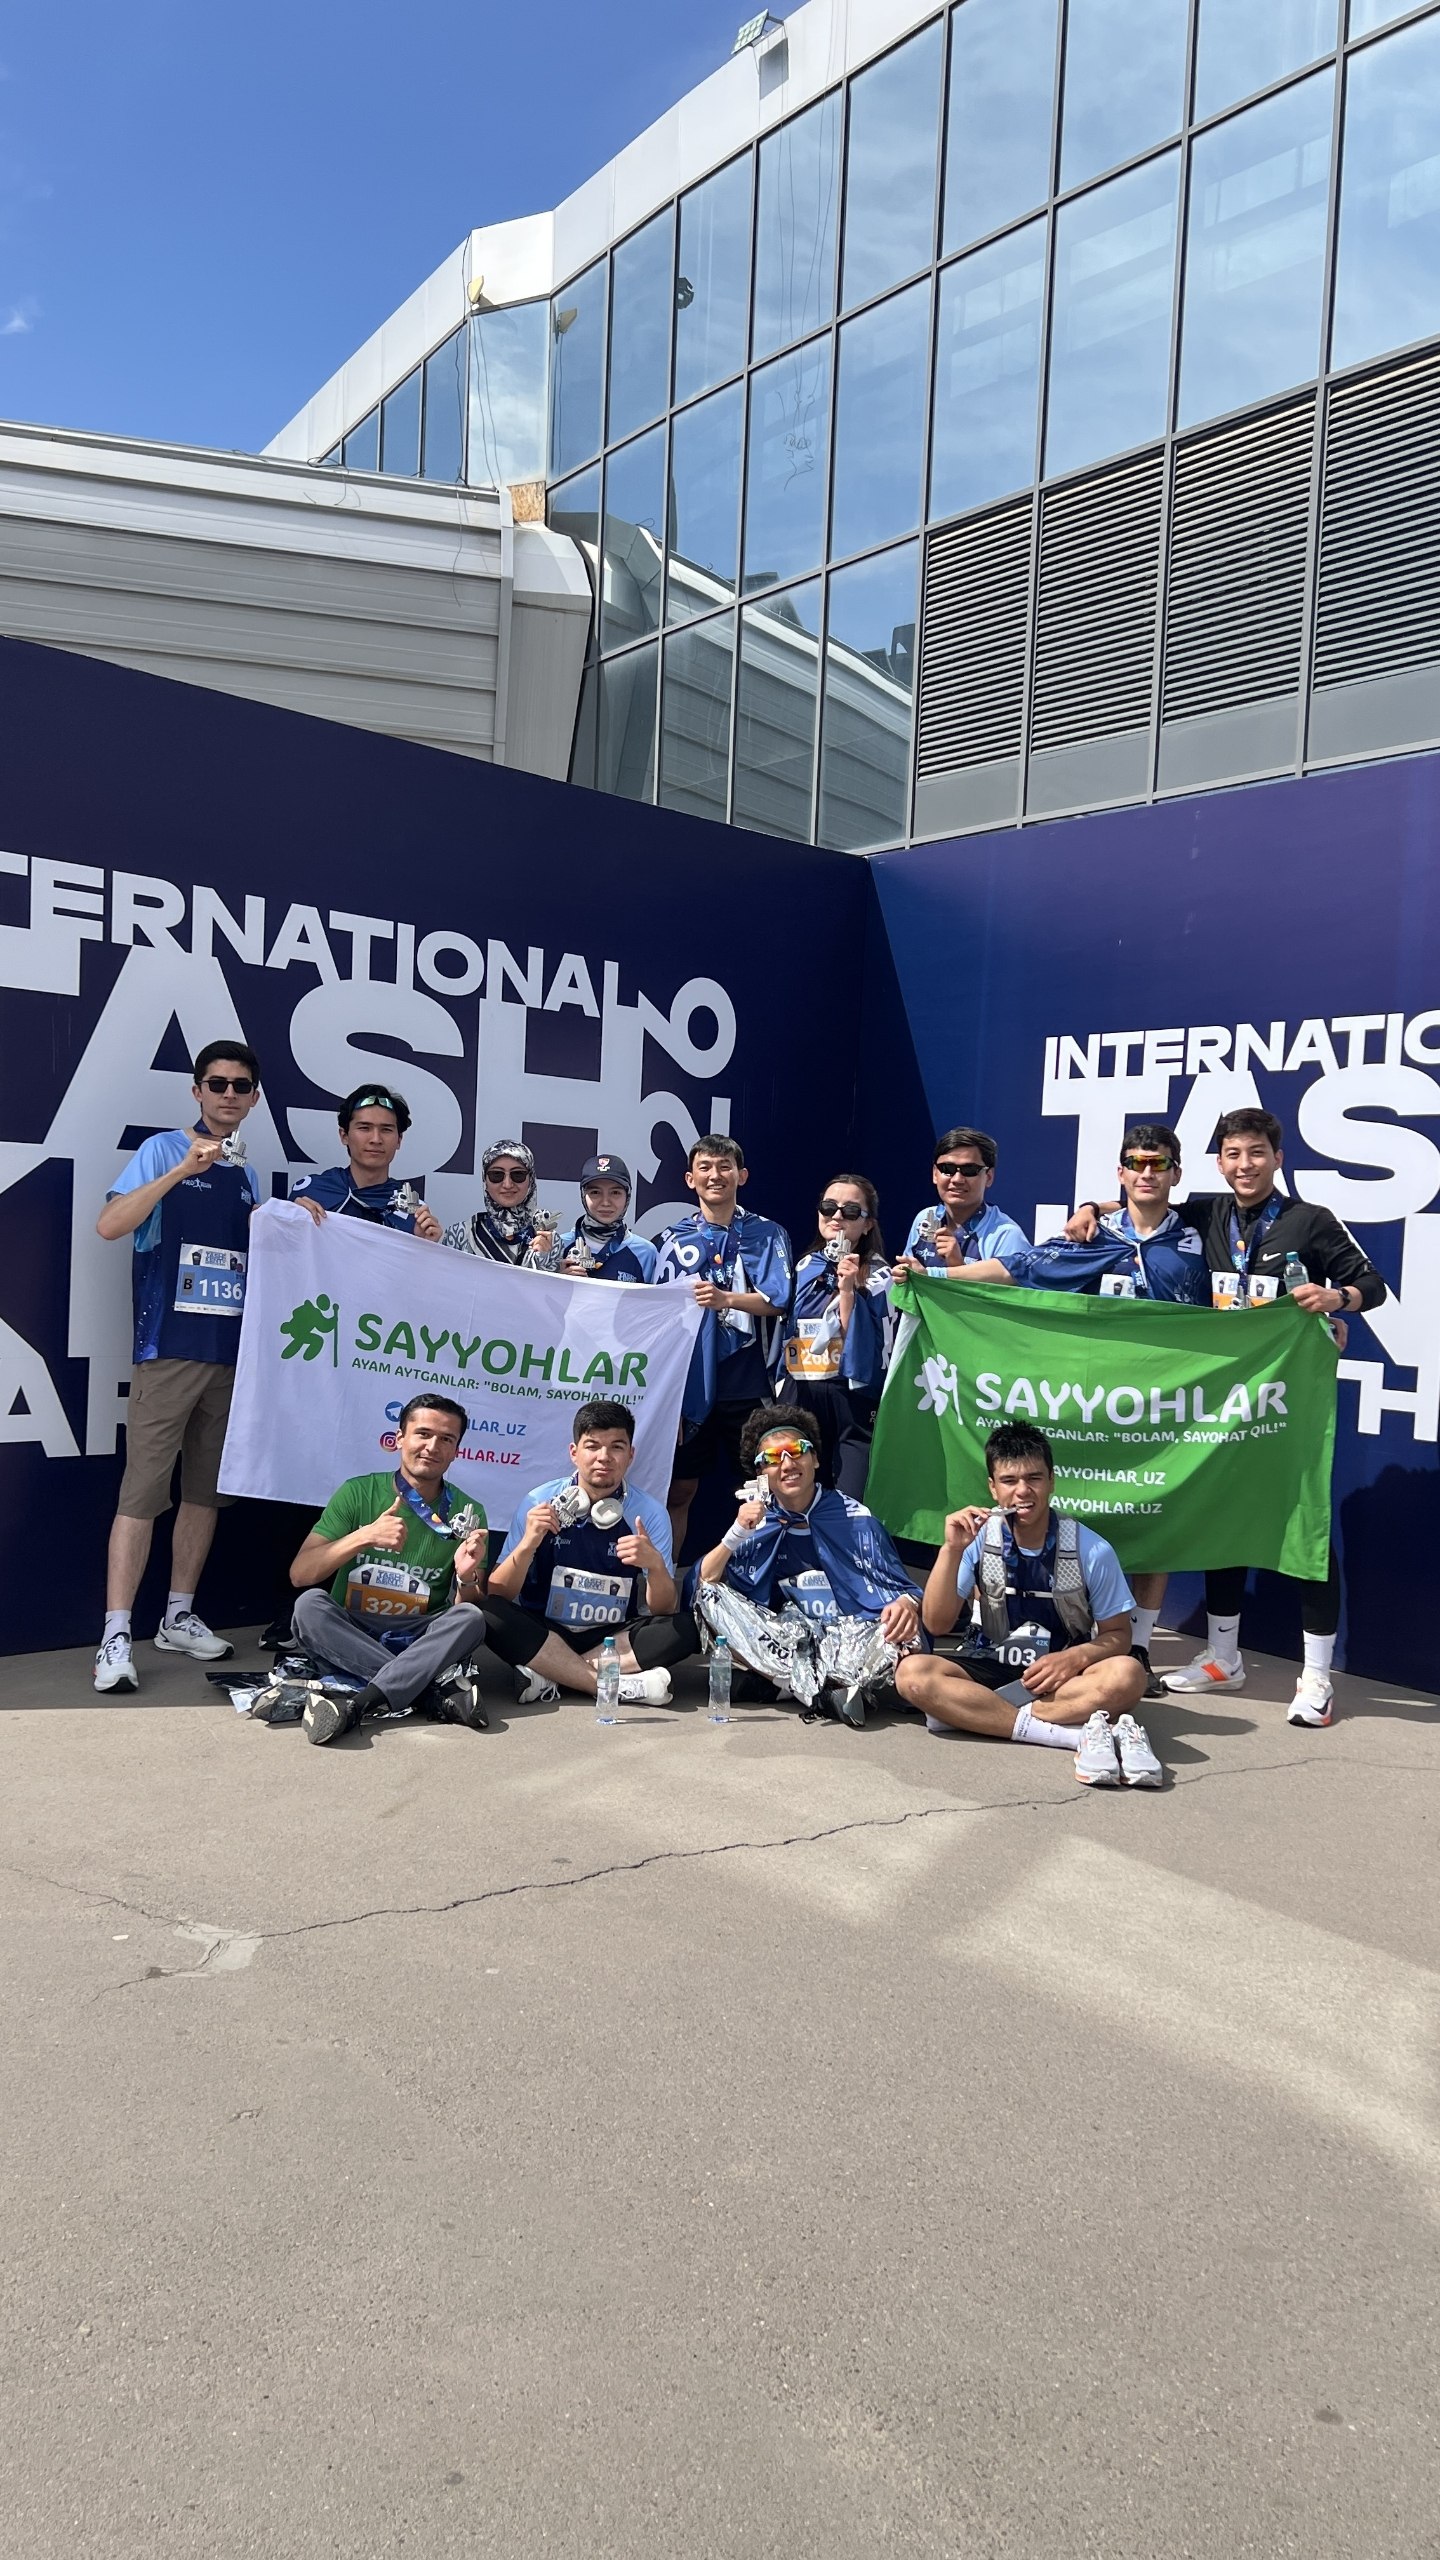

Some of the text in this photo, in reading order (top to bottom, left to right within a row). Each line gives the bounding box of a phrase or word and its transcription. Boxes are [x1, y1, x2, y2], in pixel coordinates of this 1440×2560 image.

[183, 1278, 243, 1300] B 1136
[355, 1313, 649, 1387] SAYYOHLAR
[789, 1346, 797, 1357] D
[351, 1357, 391, 1374] AYAM
[394, 1366, 480, 1390] AYTGANLAR:
[483, 1380, 542, 1400] "BOLAM,
[546, 1389, 608, 1402] SAYOHAT
[975, 1372, 1288, 1425] SAYYOHLAR
[467, 1418, 527, 1436] LAR_UZ
[1034, 1425, 1109, 1443] TGANLAR:
[1113, 1431, 1179, 1444] "BOLAM,
[1183, 1430, 1247, 1444] SAYOHAT
[455, 1447, 521, 1465] HLAR.UZ
[1053, 1465, 1166, 1486] AYYOHLAR_UZ
[1049, 1495, 1163, 1514] AYYOHLAR.UZ
[365, 1597, 421, 1616] 3224
[569, 1602, 621, 1623] 1000
[800, 1599, 844, 1617] 104
[1035, 1639, 1049, 1647] 42K
[995, 1645, 1037, 1667] 103
